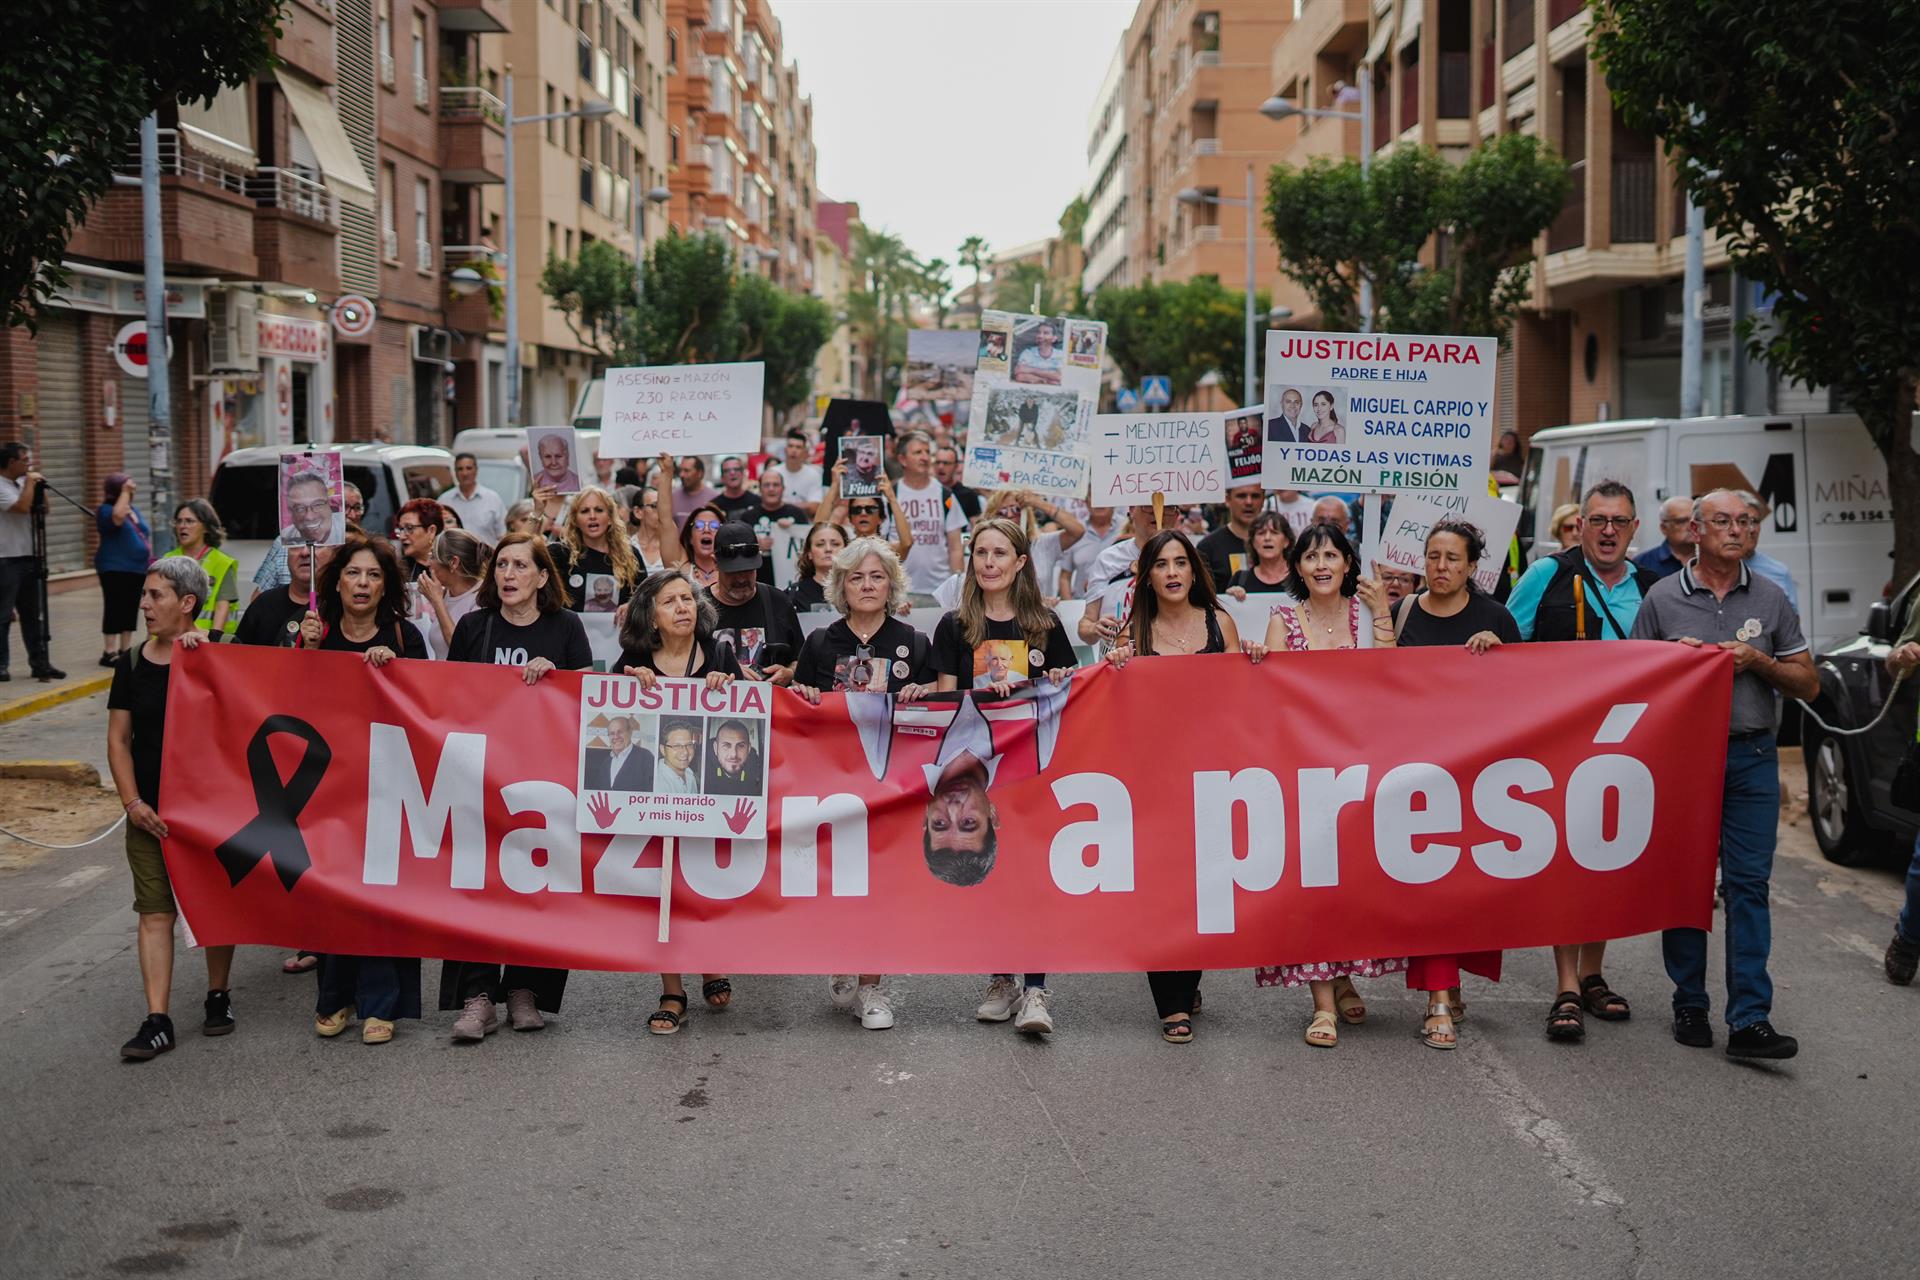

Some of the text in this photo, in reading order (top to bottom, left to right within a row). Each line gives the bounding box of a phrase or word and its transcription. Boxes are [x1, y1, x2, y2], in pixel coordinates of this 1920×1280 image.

[1280, 338, 1481, 365] JUSTICIA PARA
[683, 369, 731, 384] MAZÓN
[1331, 367, 1428, 381] PADRE E HIJA
[635, 389, 733, 405] 230 RAZONES
[615, 410, 718, 423] PARA IR A LA
[1350, 397, 1488, 417] MIGUEL CARPIO Y
[631, 428, 693, 442] CARCEL
[1125, 420, 1210, 439] MENTIRAS
[1364, 420, 1471, 439] SARA CARPIO
[1125, 444, 1213, 465] JUSTICIA
[1280, 447, 1472, 468] Y TODAS LAS VICTIMAS
[1109, 469, 1220, 496] ASESINOS
[1291, 465, 1458, 488] MAZÓN PRISIÓN
[848, 482, 876, 495] Fina
[900, 499, 940, 520] 20:11
[1840, 511, 1856, 521] 96
[1386, 543, 1425, 570] VALENC
[494, 647, 528, 667] NO
[587, 680, 766, 714] JUSTICIA
[628, 795, 716, 807] por mi marido
[638, 810, 705, 823] y mis hijos
[1049, 772, 1134, 895] a
[1194, 703, 1655, 934] presó
